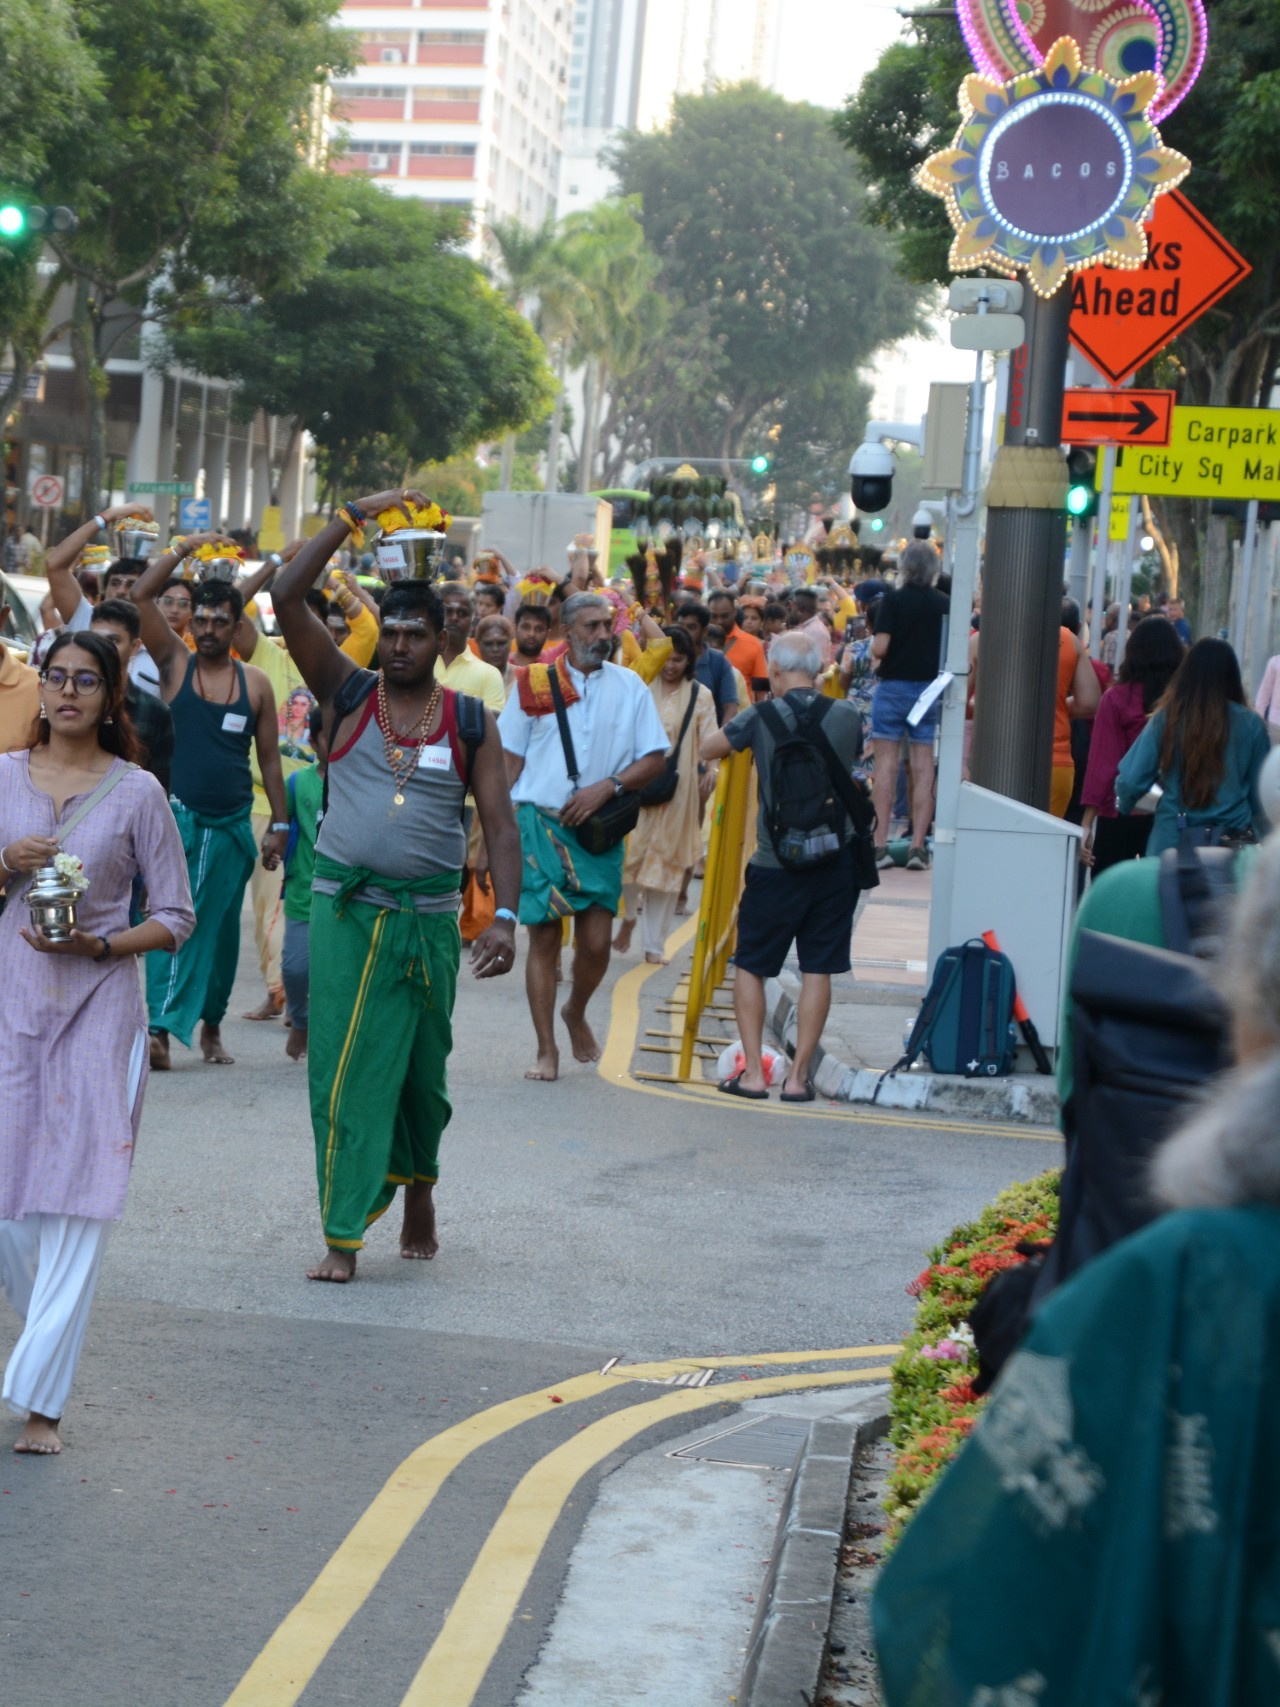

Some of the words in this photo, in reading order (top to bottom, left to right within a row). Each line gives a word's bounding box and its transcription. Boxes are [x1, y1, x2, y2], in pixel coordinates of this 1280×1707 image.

[1070, 275, 1181, 316] Ahead
[1187, 419, 1277, 449] Carpark
[1139, 454, 1183, 483] City
[1198, 456, 1223, 485] Sq
